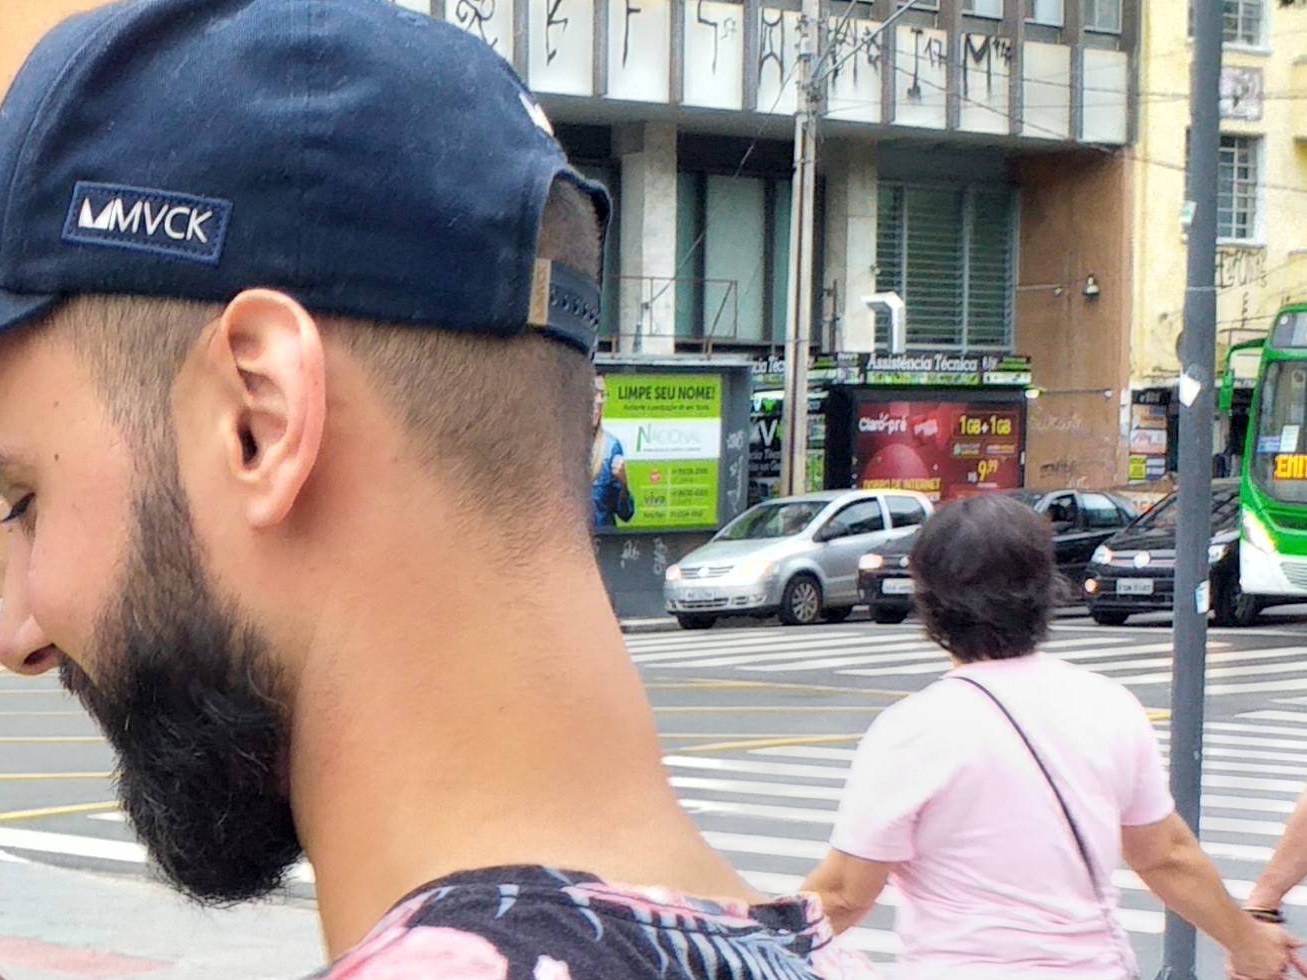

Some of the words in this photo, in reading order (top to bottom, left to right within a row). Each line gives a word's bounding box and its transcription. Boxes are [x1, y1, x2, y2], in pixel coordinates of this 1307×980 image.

[109, 197, 213, 243] MVCK
[866, 353, 932, 370] Assistência
[933, 353, 978, 371] Técnica
[618, 386, 652, 400] LIMPE
[654, 386, 676, 400] SEU
[677, 385, 715, 399] NOME!
